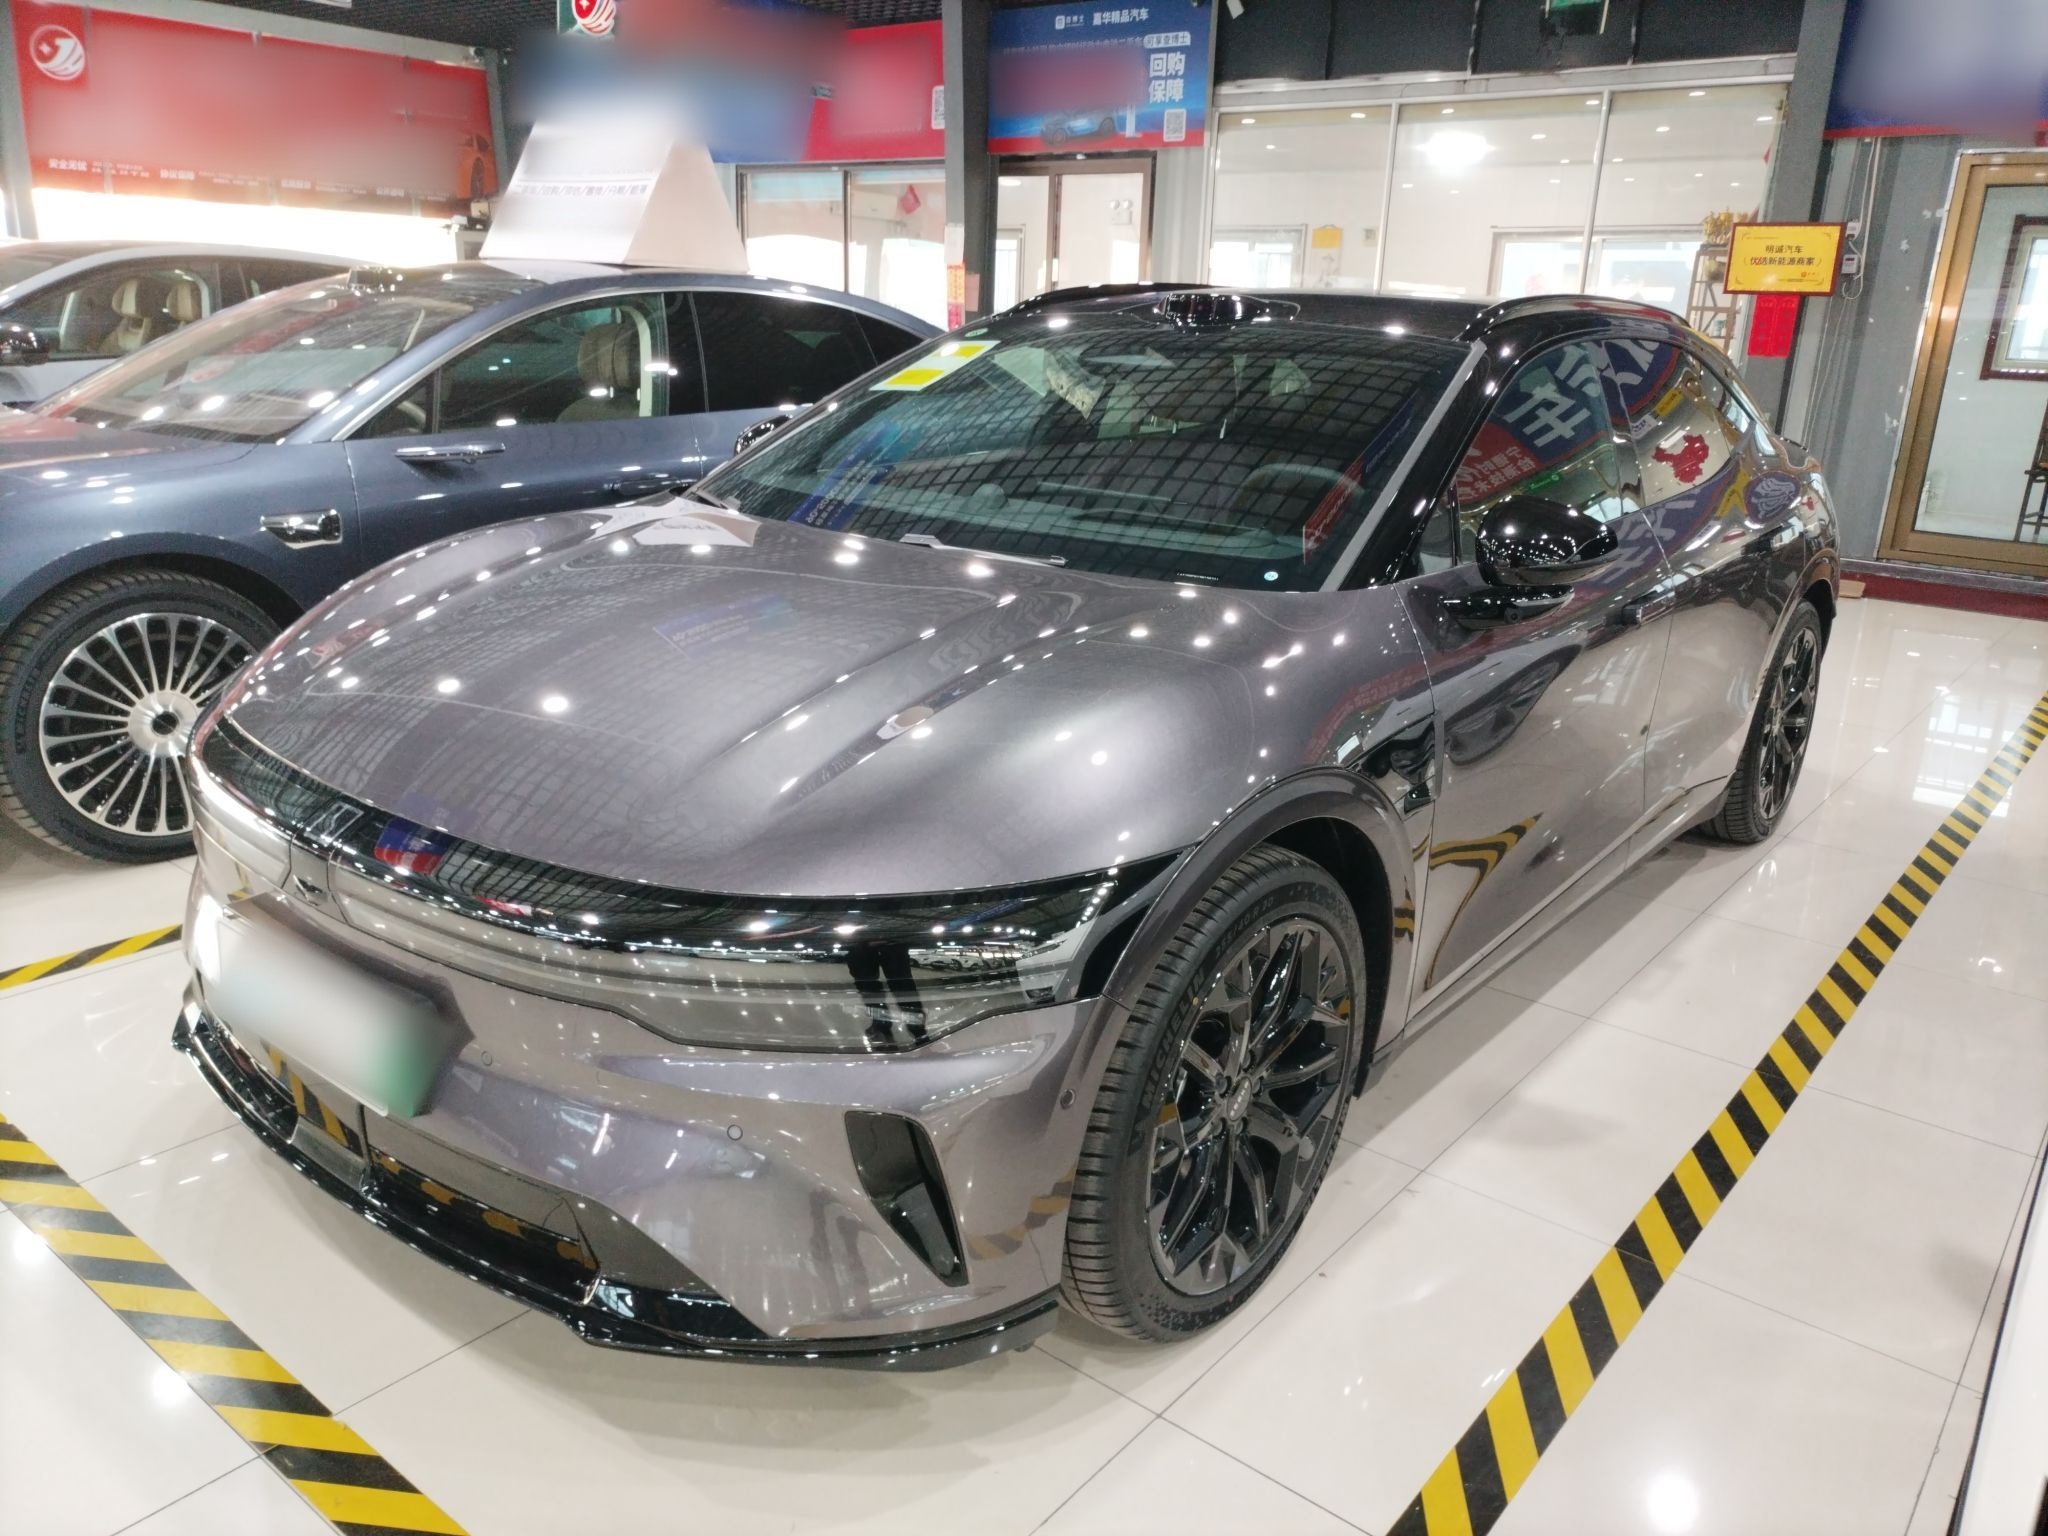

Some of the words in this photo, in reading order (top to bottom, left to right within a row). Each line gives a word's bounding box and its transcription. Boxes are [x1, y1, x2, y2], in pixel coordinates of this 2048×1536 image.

[1149, 52, 1185, 78] 回购
[1148, 78, 1184, 103] 保障
[1141, 967, 1206, 1109] MICHELIN
